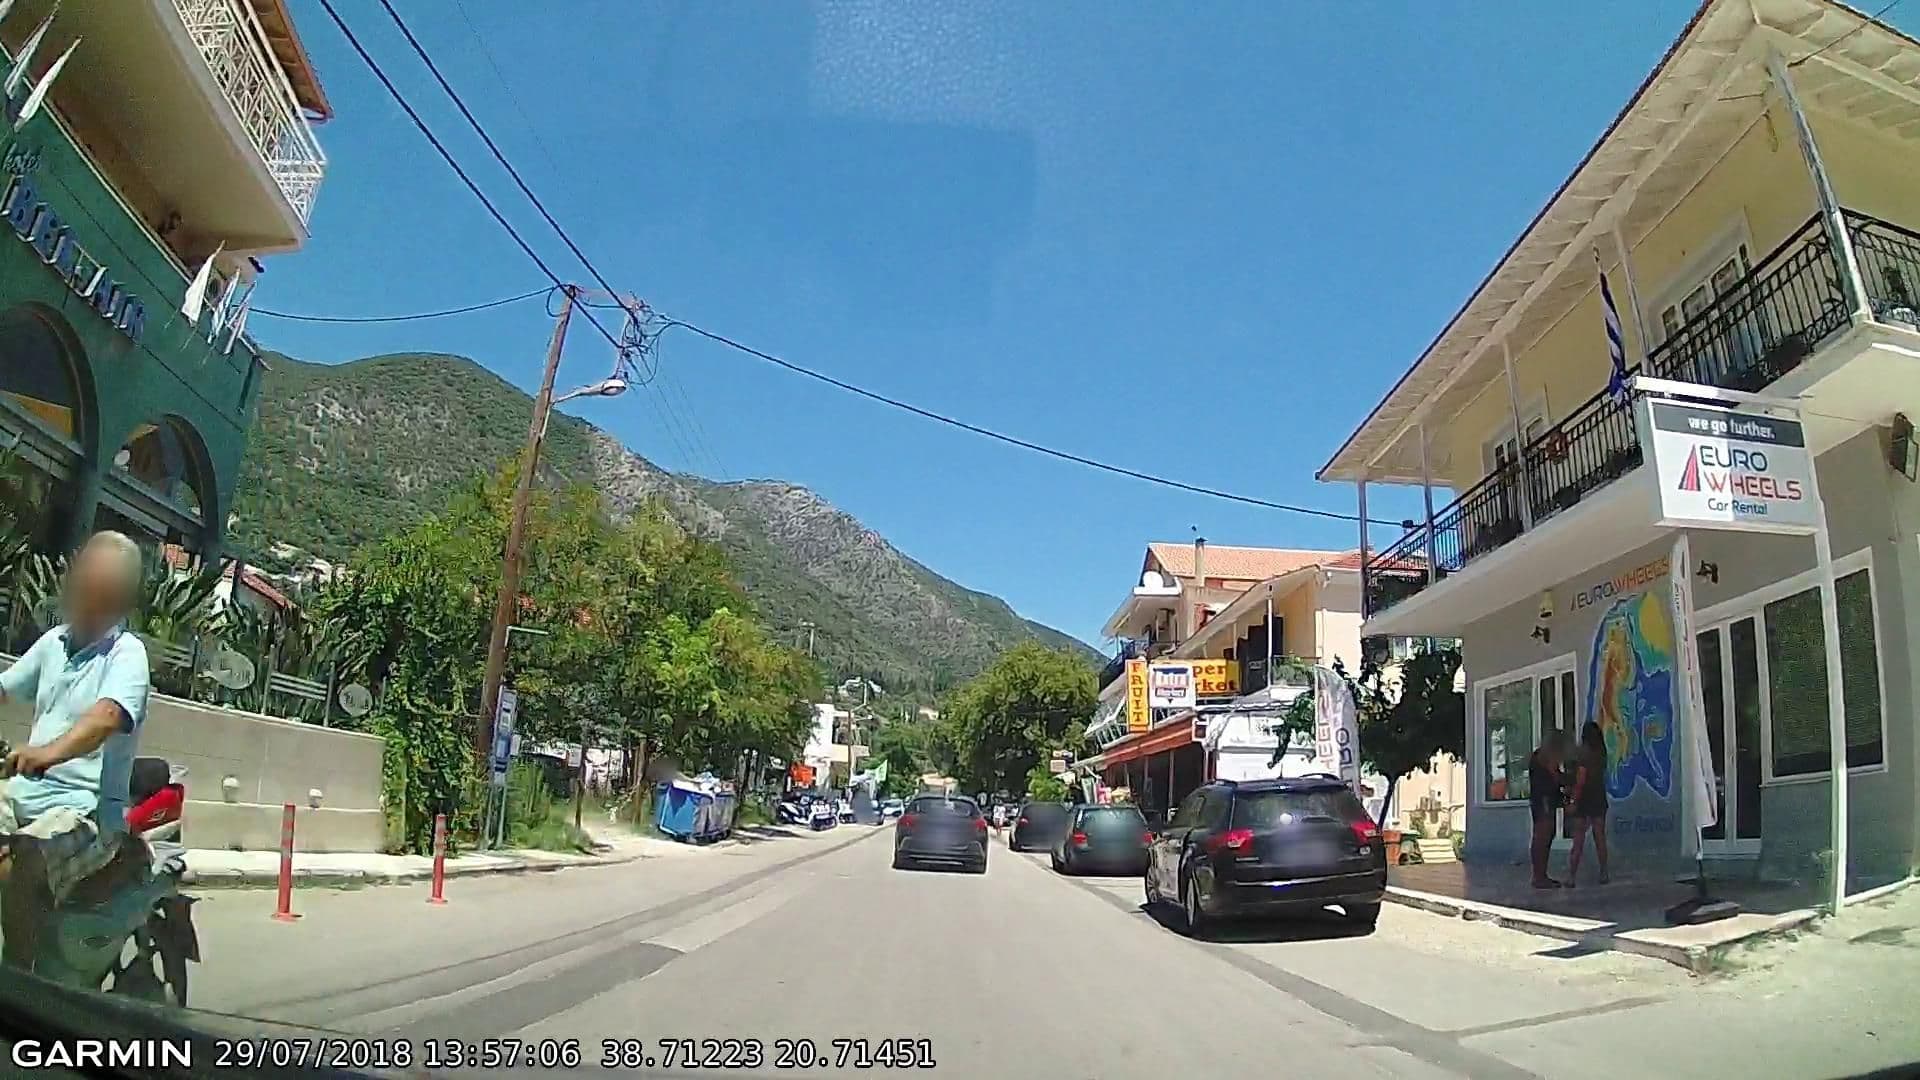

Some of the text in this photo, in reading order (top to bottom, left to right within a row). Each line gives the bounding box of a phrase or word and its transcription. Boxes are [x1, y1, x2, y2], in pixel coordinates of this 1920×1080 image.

[1687, 416, 1709, 430] we
[1711, 419, 1728, 435] go
[1700, 445, 1768, 472] EURO
[1703, 470, 1802, 501] WHEELS
[1707, 497, 1768, 515] Car Rental
[1192, 665, 1225, 677] per
[1130, 662, 1144, 722] FRUIT
[1195, 679, 1237, 692] rket
